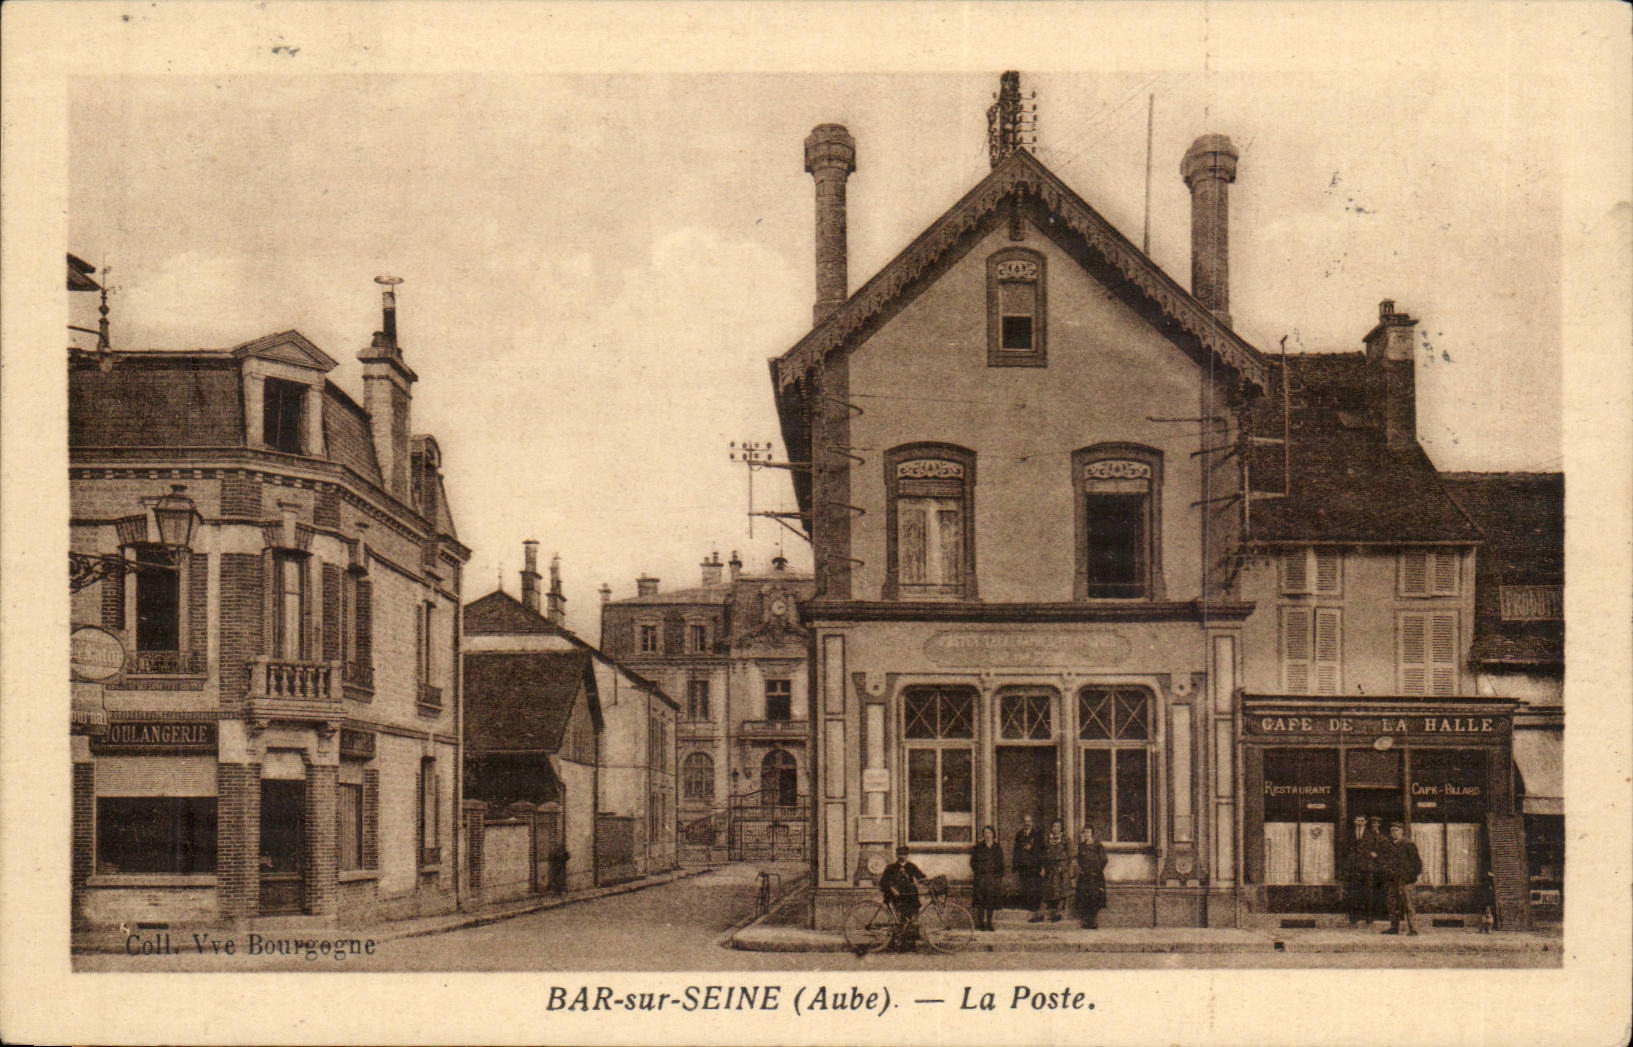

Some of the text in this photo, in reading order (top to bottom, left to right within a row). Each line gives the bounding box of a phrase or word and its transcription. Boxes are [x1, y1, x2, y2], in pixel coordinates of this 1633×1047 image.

[1329, 718, 1353, 732] DE
[1382, 718, 1407, 732] LA
[1424, 718, 1493, 732] HALLE
[101, 725, 208, 743] OULANGERIE
